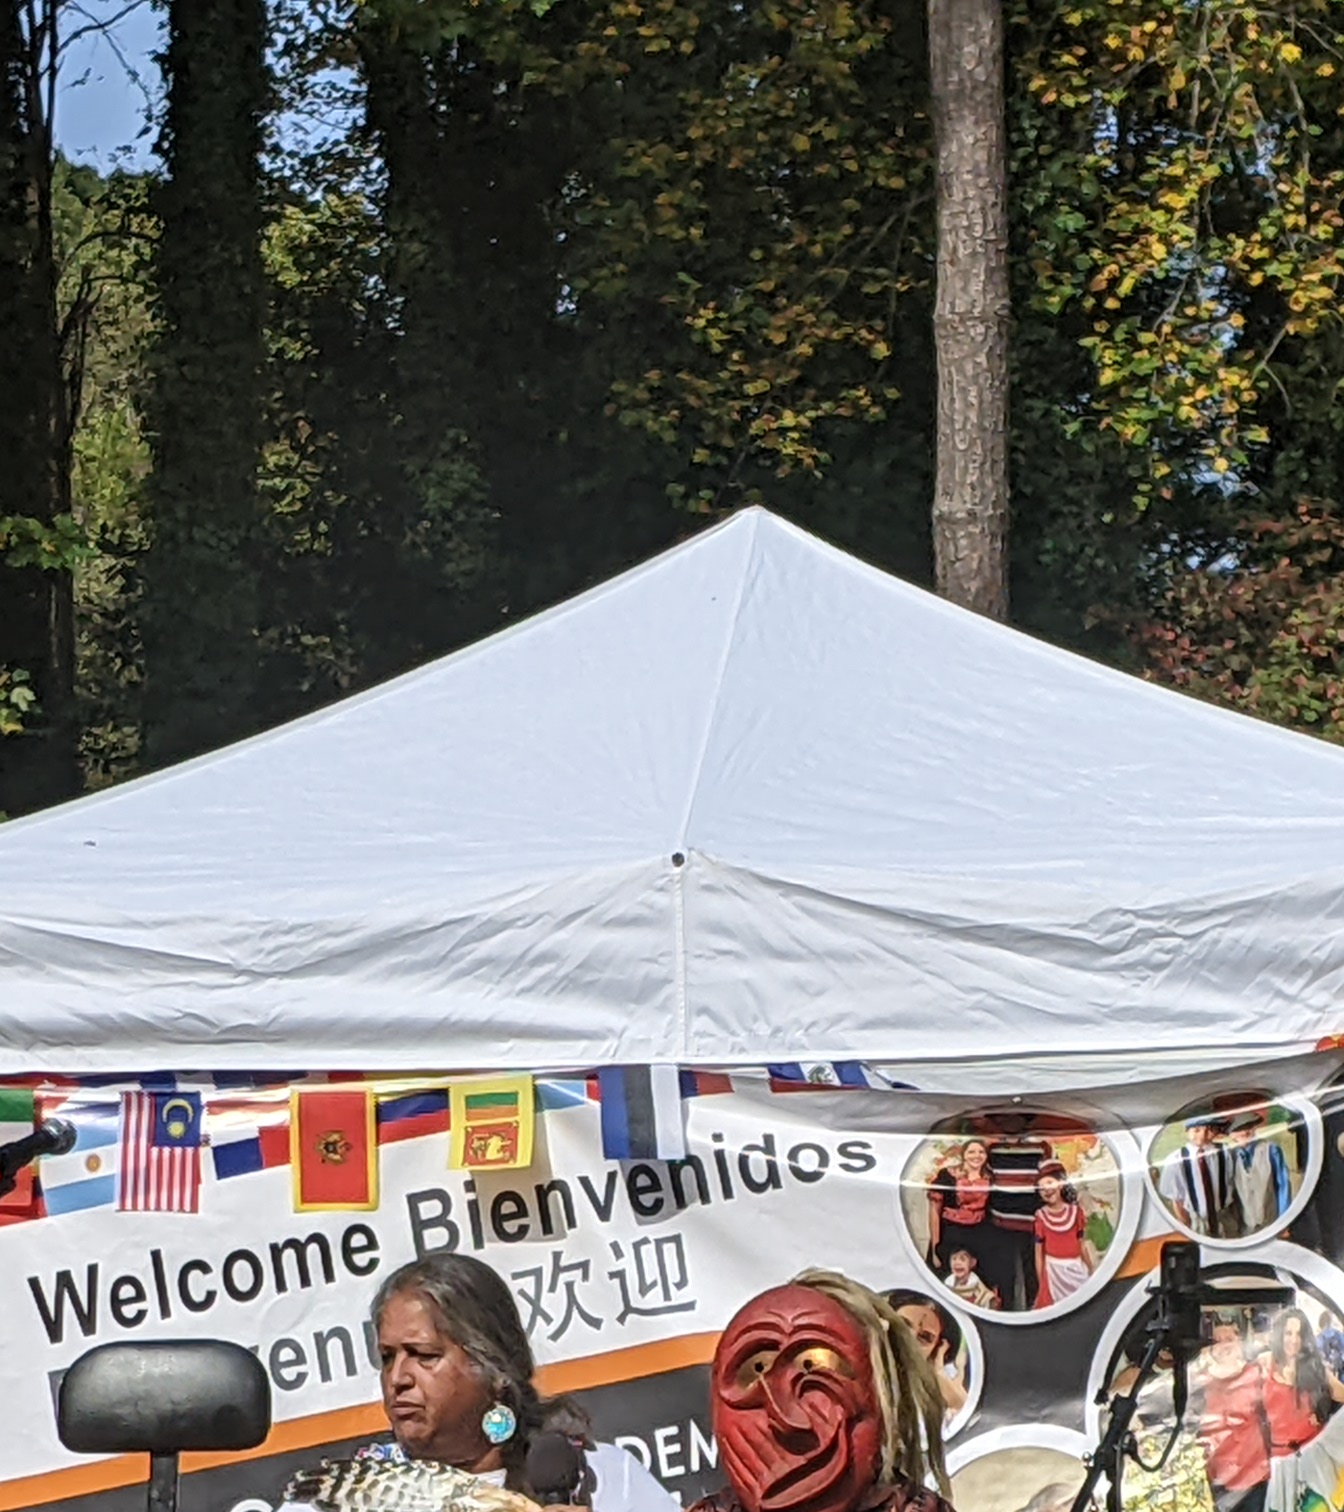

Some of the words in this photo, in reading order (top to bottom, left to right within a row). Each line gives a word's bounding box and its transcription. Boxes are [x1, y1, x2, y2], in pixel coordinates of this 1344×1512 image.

[27, 1223, 381, 1345] Welcome
[406, 1132, 878, 1261] Bienvenidos
[511, 1232, 697, 1342] 欢迎
